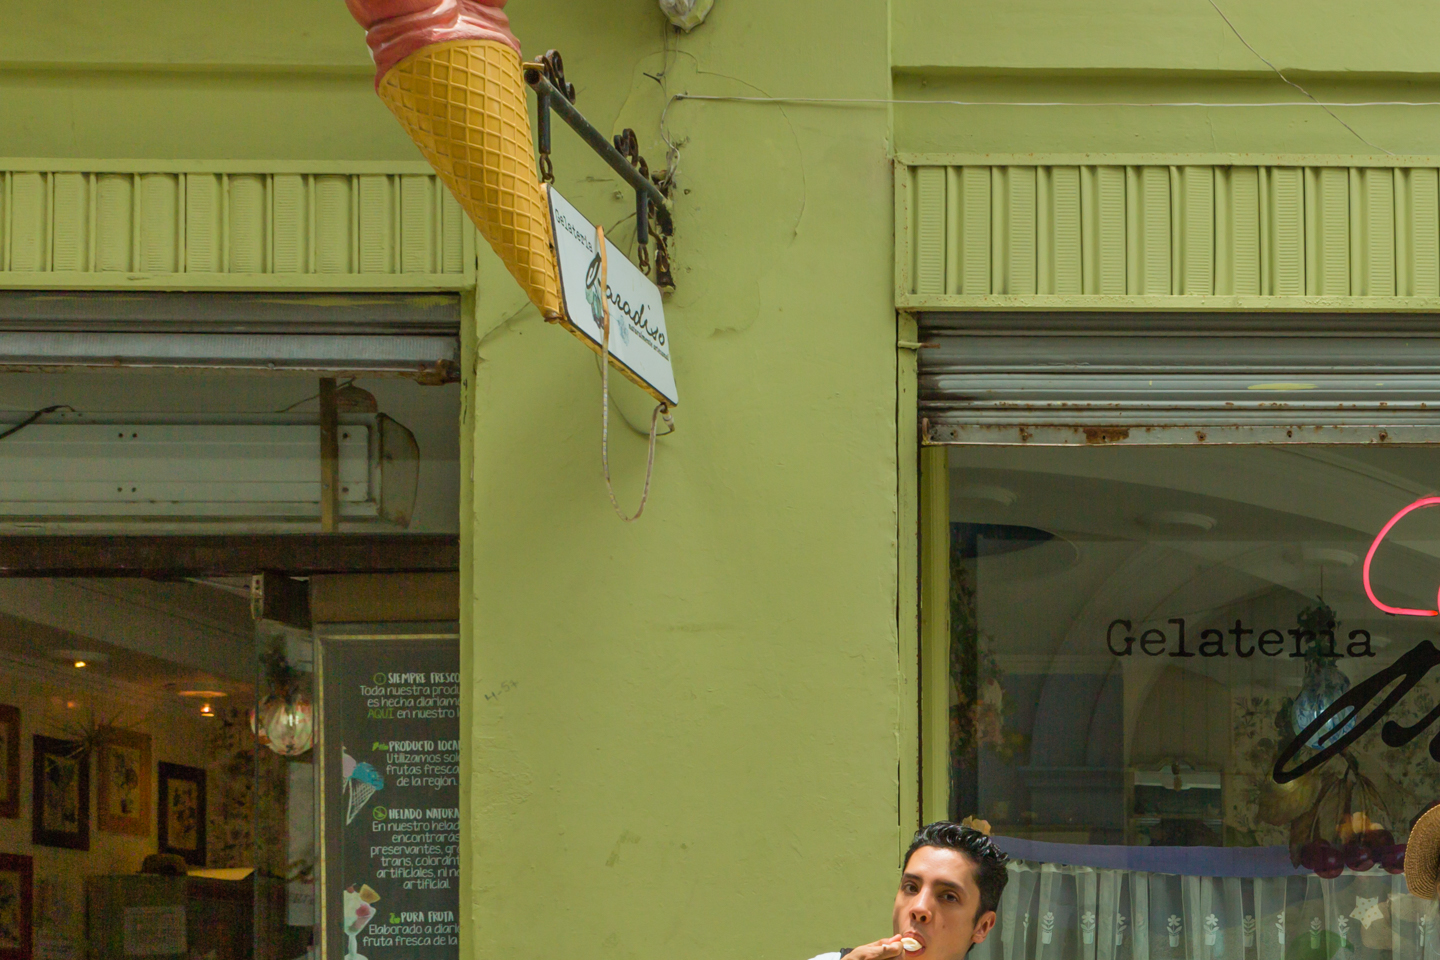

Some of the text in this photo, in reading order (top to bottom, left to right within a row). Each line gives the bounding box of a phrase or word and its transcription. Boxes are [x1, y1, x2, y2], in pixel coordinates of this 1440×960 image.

[555, 208, 593, 253] Gelateria
[1106, 617, 1376, 657] Gelateria
[388, 672, 426, 684] SIEMPRE
[360, 685, 385, 696] Toda
[387, 685, 430, 696] nuestra
[367, 699, 379, 707] es
[381, 697, 414, 707] hecha
[396, 709, 410, 718] en
[412, 708, 455, 718] nuestro
[389, 740, 434, 752] PRODUCTO
[386, 753, 441, 763] Utilizamos
[386, 764, 422, 775] frutas
[396, 776, 409, 787] de
[411, 776, 421, 786] la
[388, 808, 422, 820] HELADO
[372, 821, 386, 832] En
[387, 820, 430, 831] nuestro
[400, 911, 454, 923] PURA FRUTA
[368, 924, 423, 935] Elaborado
[424, 925, 432, 934] a
[362, 935, 458, 947] fruta fresca de la
